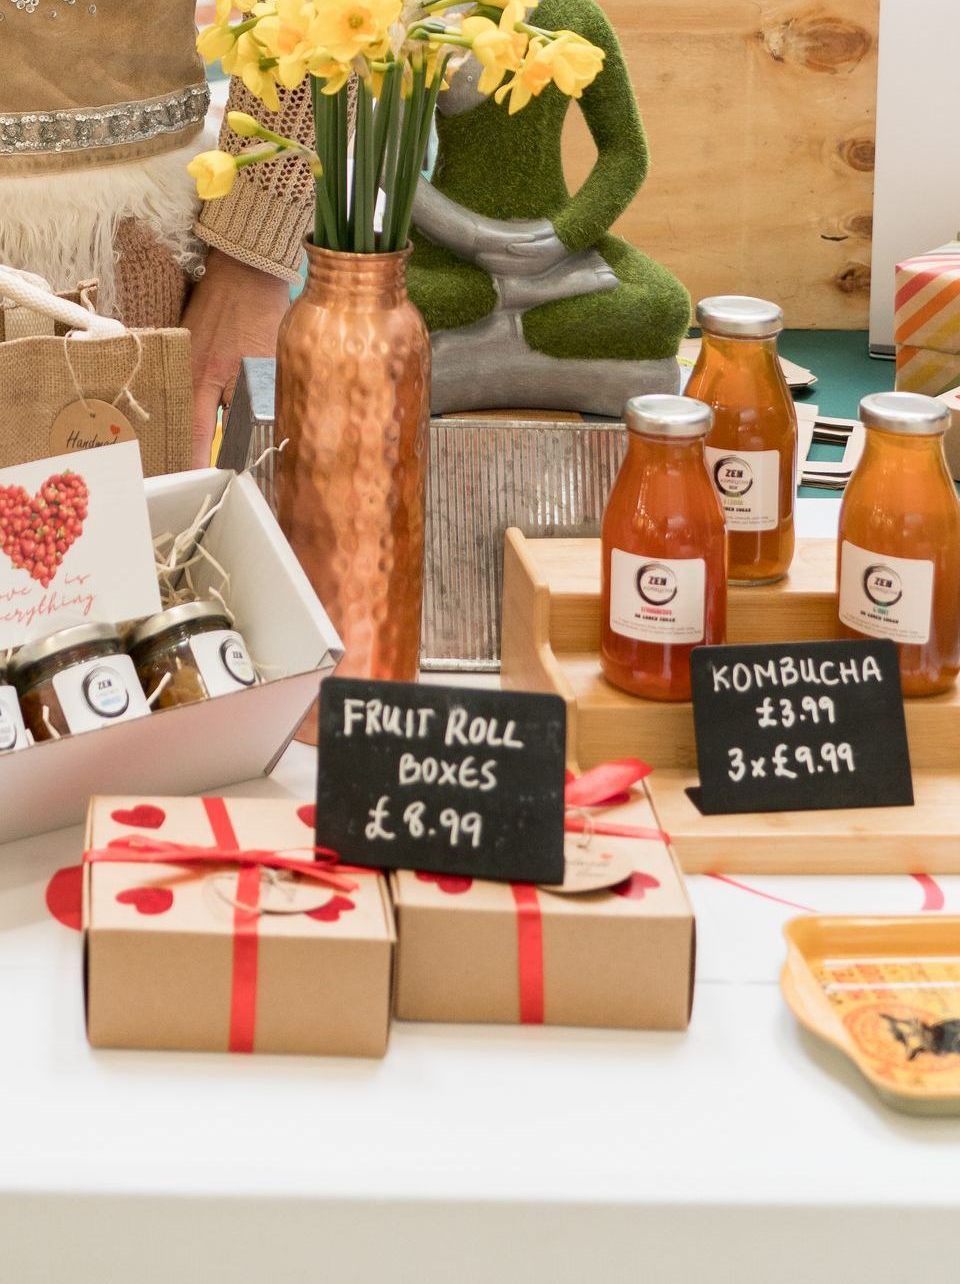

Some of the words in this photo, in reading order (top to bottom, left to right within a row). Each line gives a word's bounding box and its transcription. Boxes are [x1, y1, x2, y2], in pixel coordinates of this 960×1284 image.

[66, 430, 118, 448] Handmad
[725, 469, 743, 478] ZEN
[64, 572, 91, 585] is
[649, 576, 667, 586] ZEN
[874, 577, 892, 588] ZEN
[712, 655, 883, 692] KOMBUCHA
[755, 695, 836, 728] £3.99
[343, 699, 435, 739] FRUIT
[444, 707, 524, 748] ROLL
[398, 752, 498, 791] BOXES
